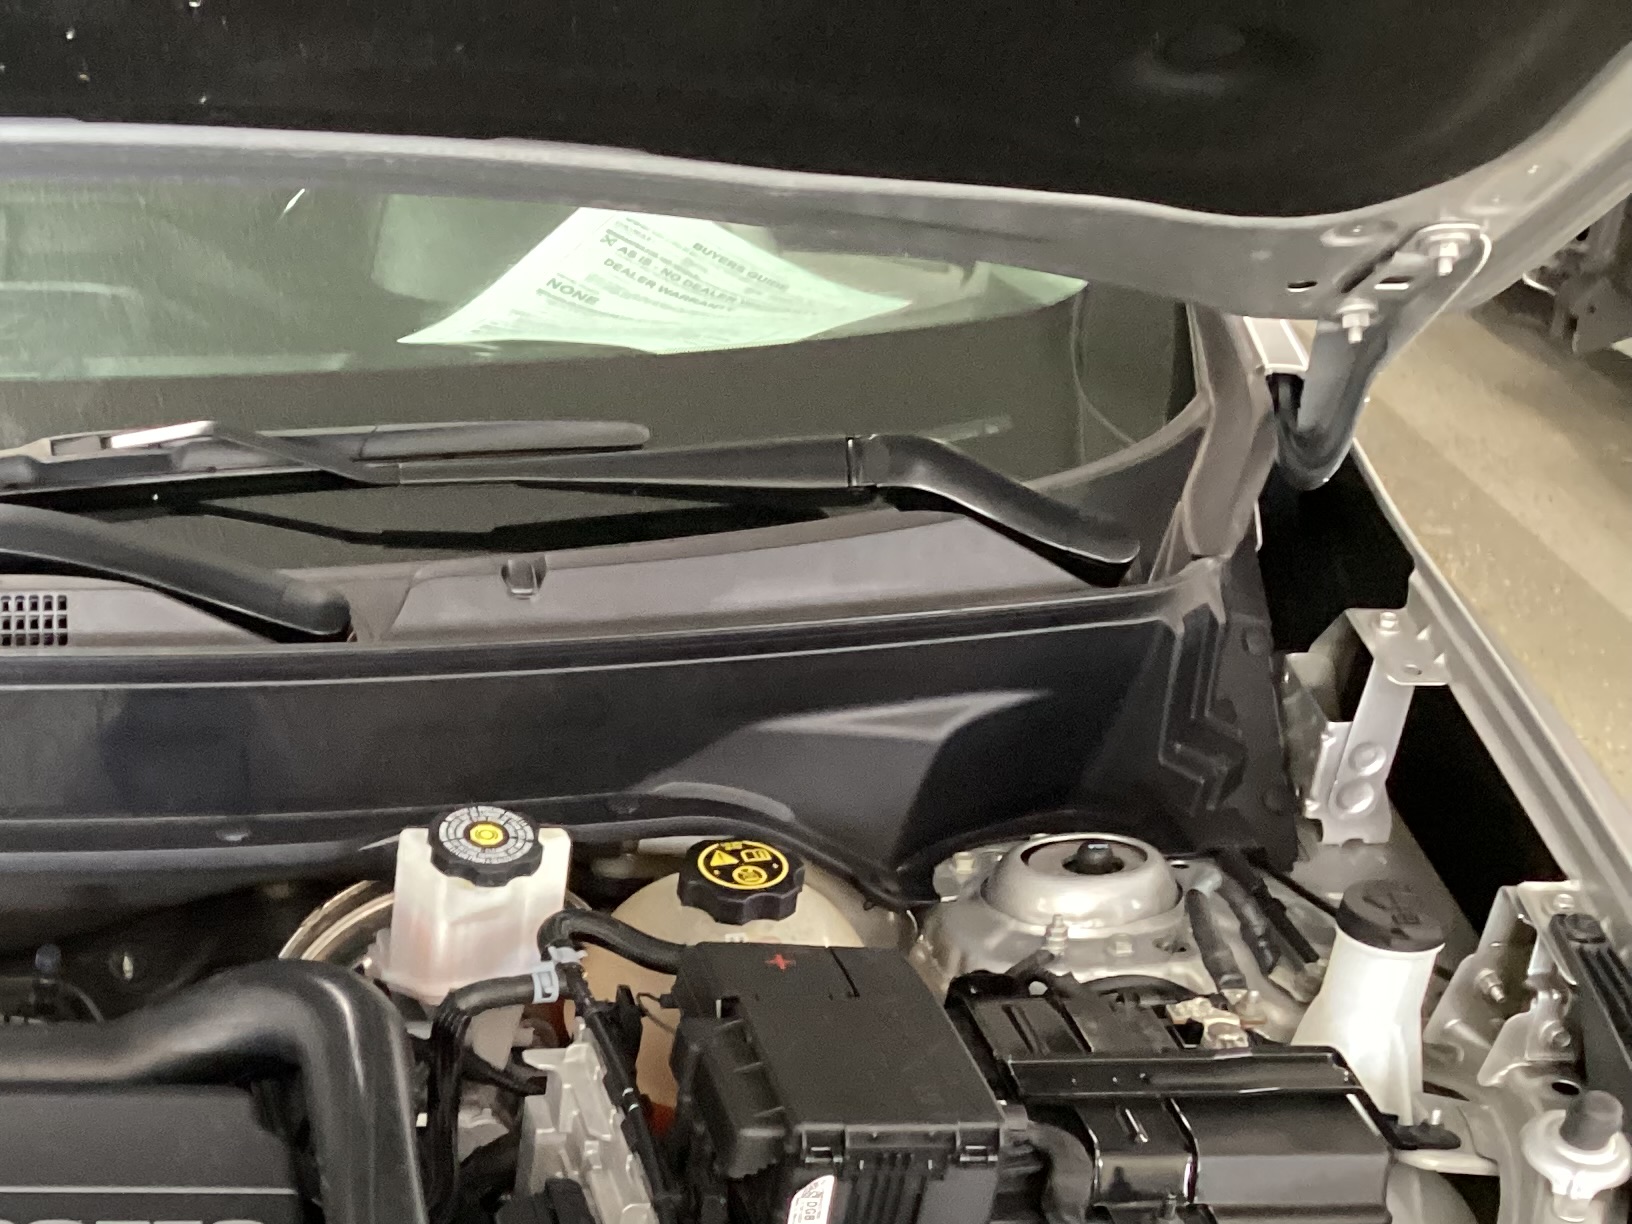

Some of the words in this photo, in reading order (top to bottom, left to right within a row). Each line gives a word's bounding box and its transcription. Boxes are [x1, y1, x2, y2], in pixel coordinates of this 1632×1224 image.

[604, 257, 657, 289] DEALER
[693, 242, 745, 273] BUYERS
[546, 277, 600, 306] NONE
[660, 267, 681, 282] NO
[683, 279, 737, 303] DEALER
